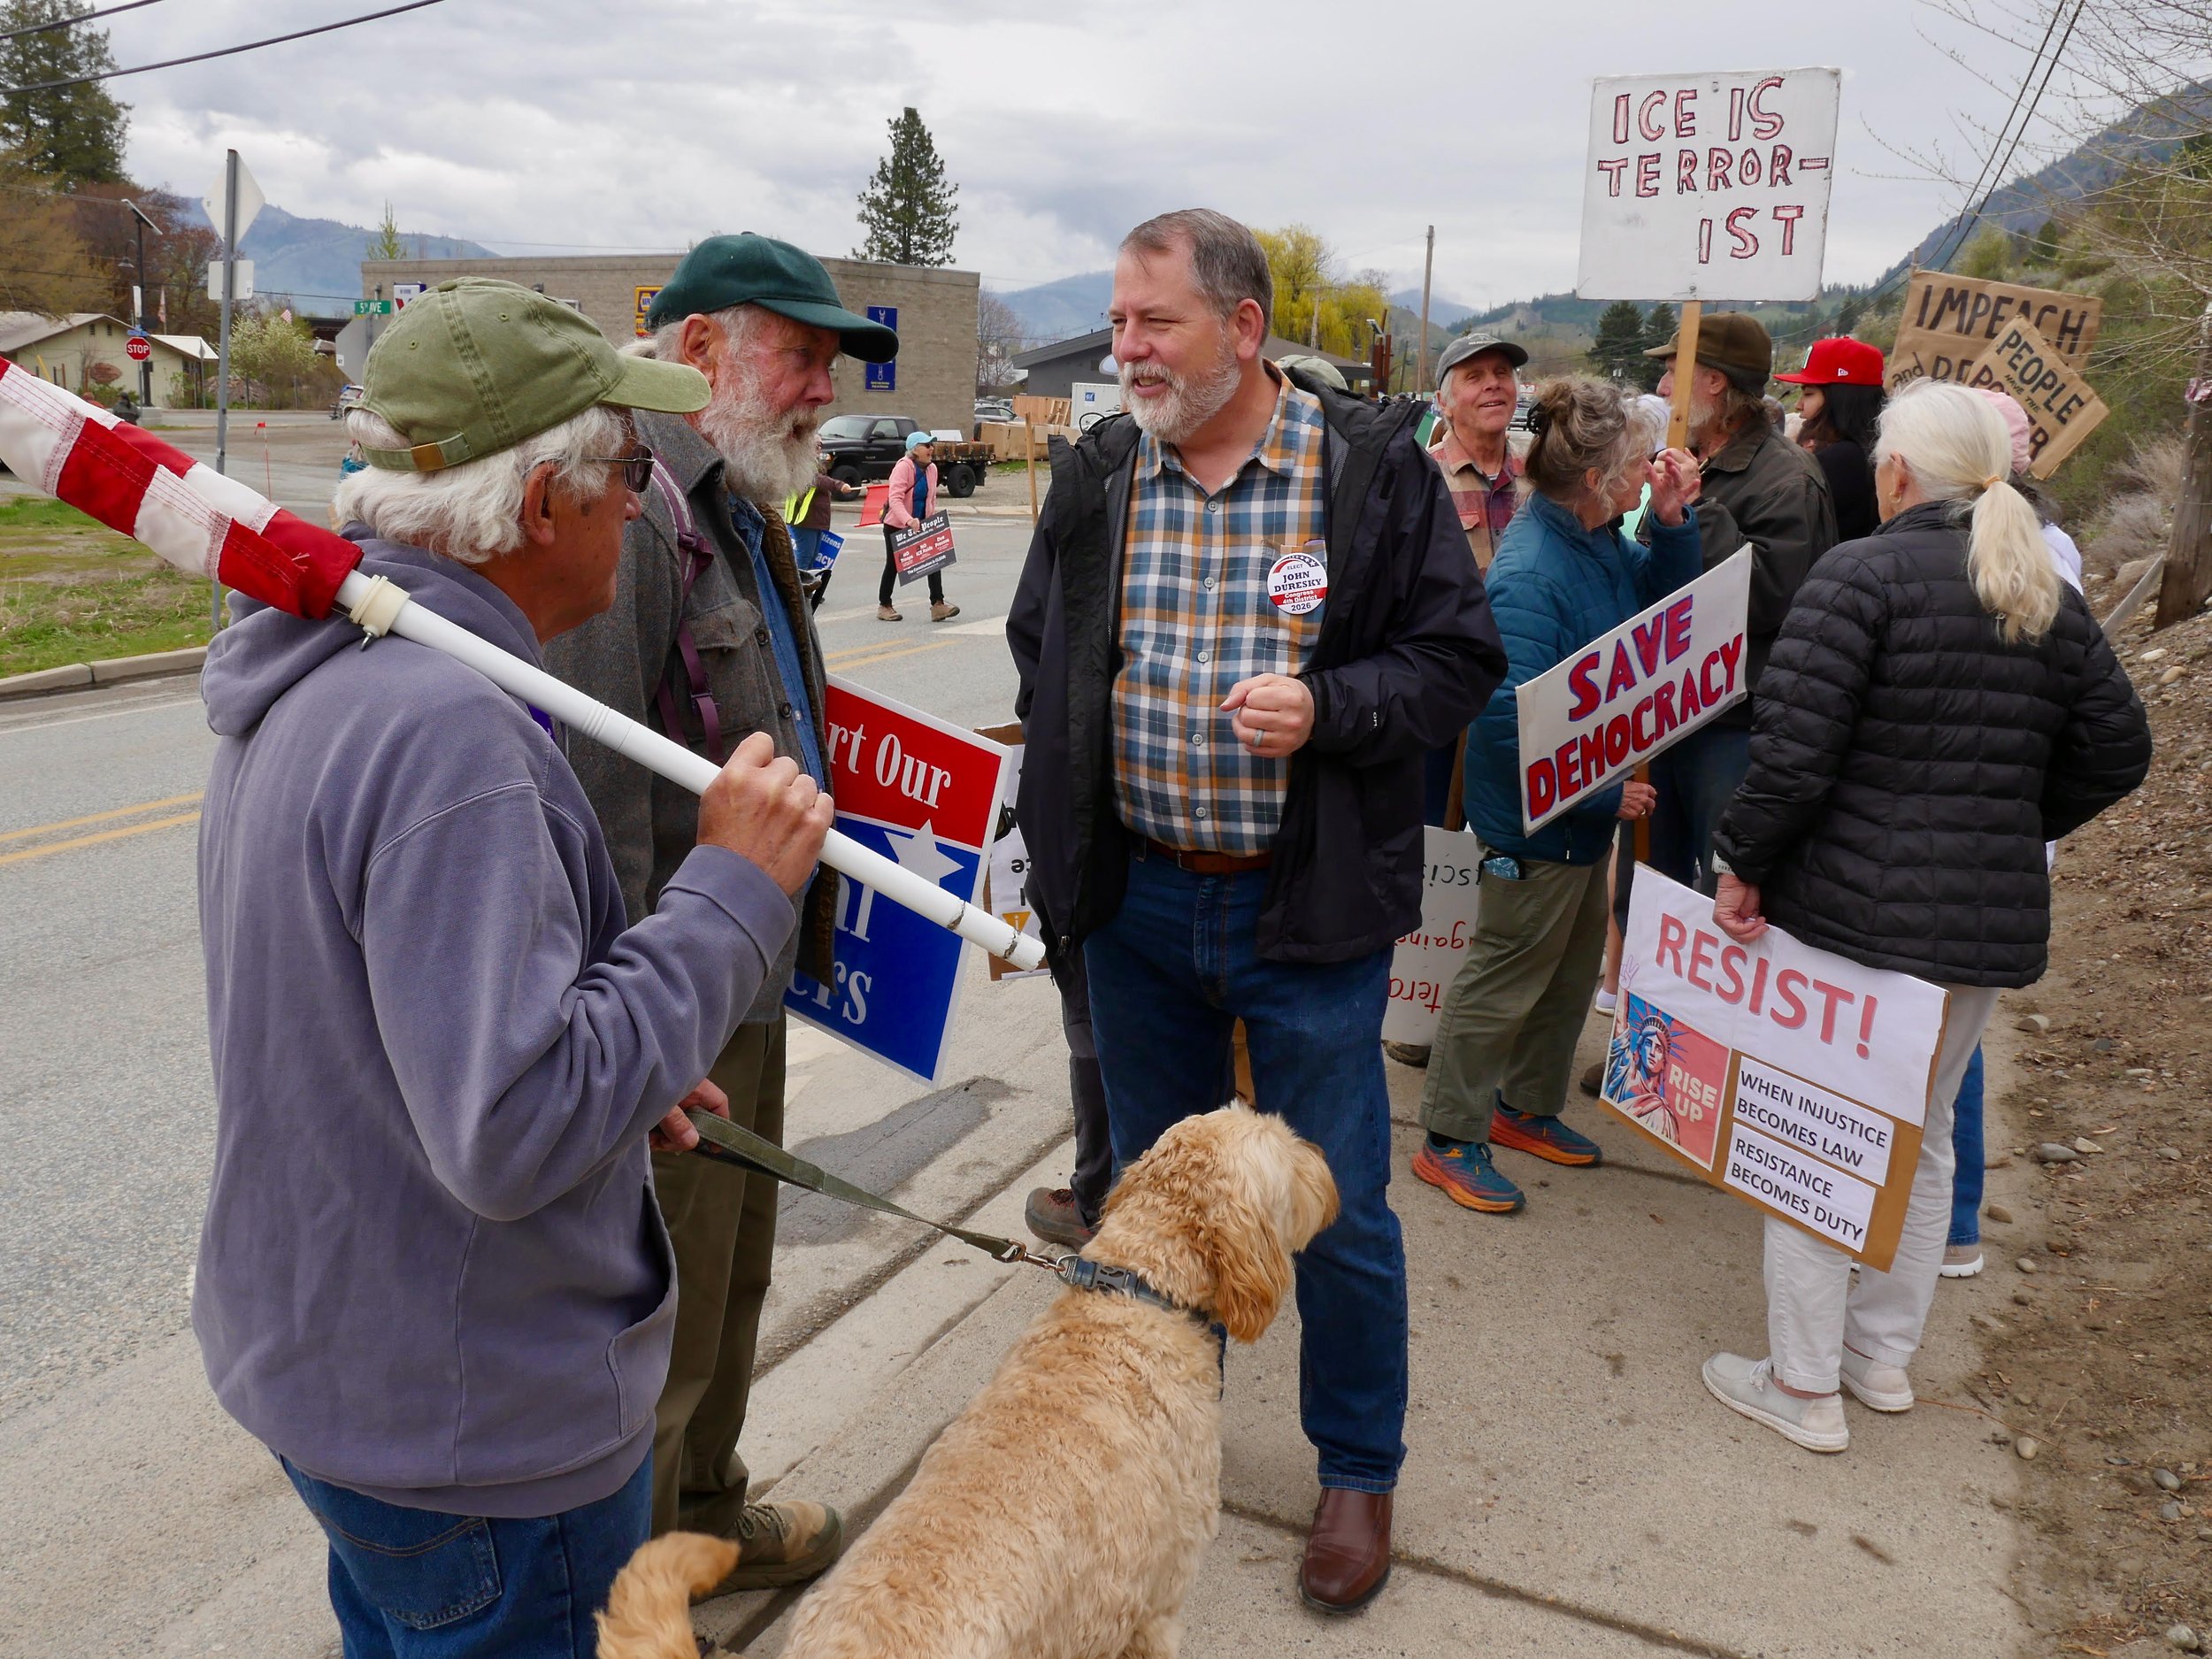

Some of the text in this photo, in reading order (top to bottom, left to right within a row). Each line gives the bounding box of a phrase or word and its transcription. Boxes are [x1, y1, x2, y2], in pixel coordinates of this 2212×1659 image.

[1612, 75, 1786, 144] ICE IS
[1597, 143, 1830, 198] TERROR-
[1697, 205, 1805, 265] IST
[368, 302, 382, 312] AVE
[127, 343, 150, 354] STOP
[1892, 351, 1924, 386] and
[1995, 328, 2085, 426] PEOPLE
[2004, 374, 2041, 413] HAVE THE
[1274, 579, 1322, 593] DURESKY
[1283, 571, 1310, 584] JOHN
[1284, 590, 1314, 599] Congress
[1294, 595, 1317, 603] District
[1291, 602, 1311, 611] 2026
[1568, 594, 1694, 723] SAVE
[1525, 632, 1744, 822] DEMOCRACY
[875, 733, 951, 809] Our
[1655, 912, 1878, 1061] RESIST!
[1668, 1063, 1718, 1110] RISE
[1674, 1094, 1704, 1125] UP
[1740, 1070, 1888, 1148] WHEN INJUSTICE
[1736, 1098, 1863, 1168] BECOMES LAW
[1735, 1138, 1834, 1199] RESISTANCE
[1731, 1162, 1863, 1241] BECOMES DUTY
